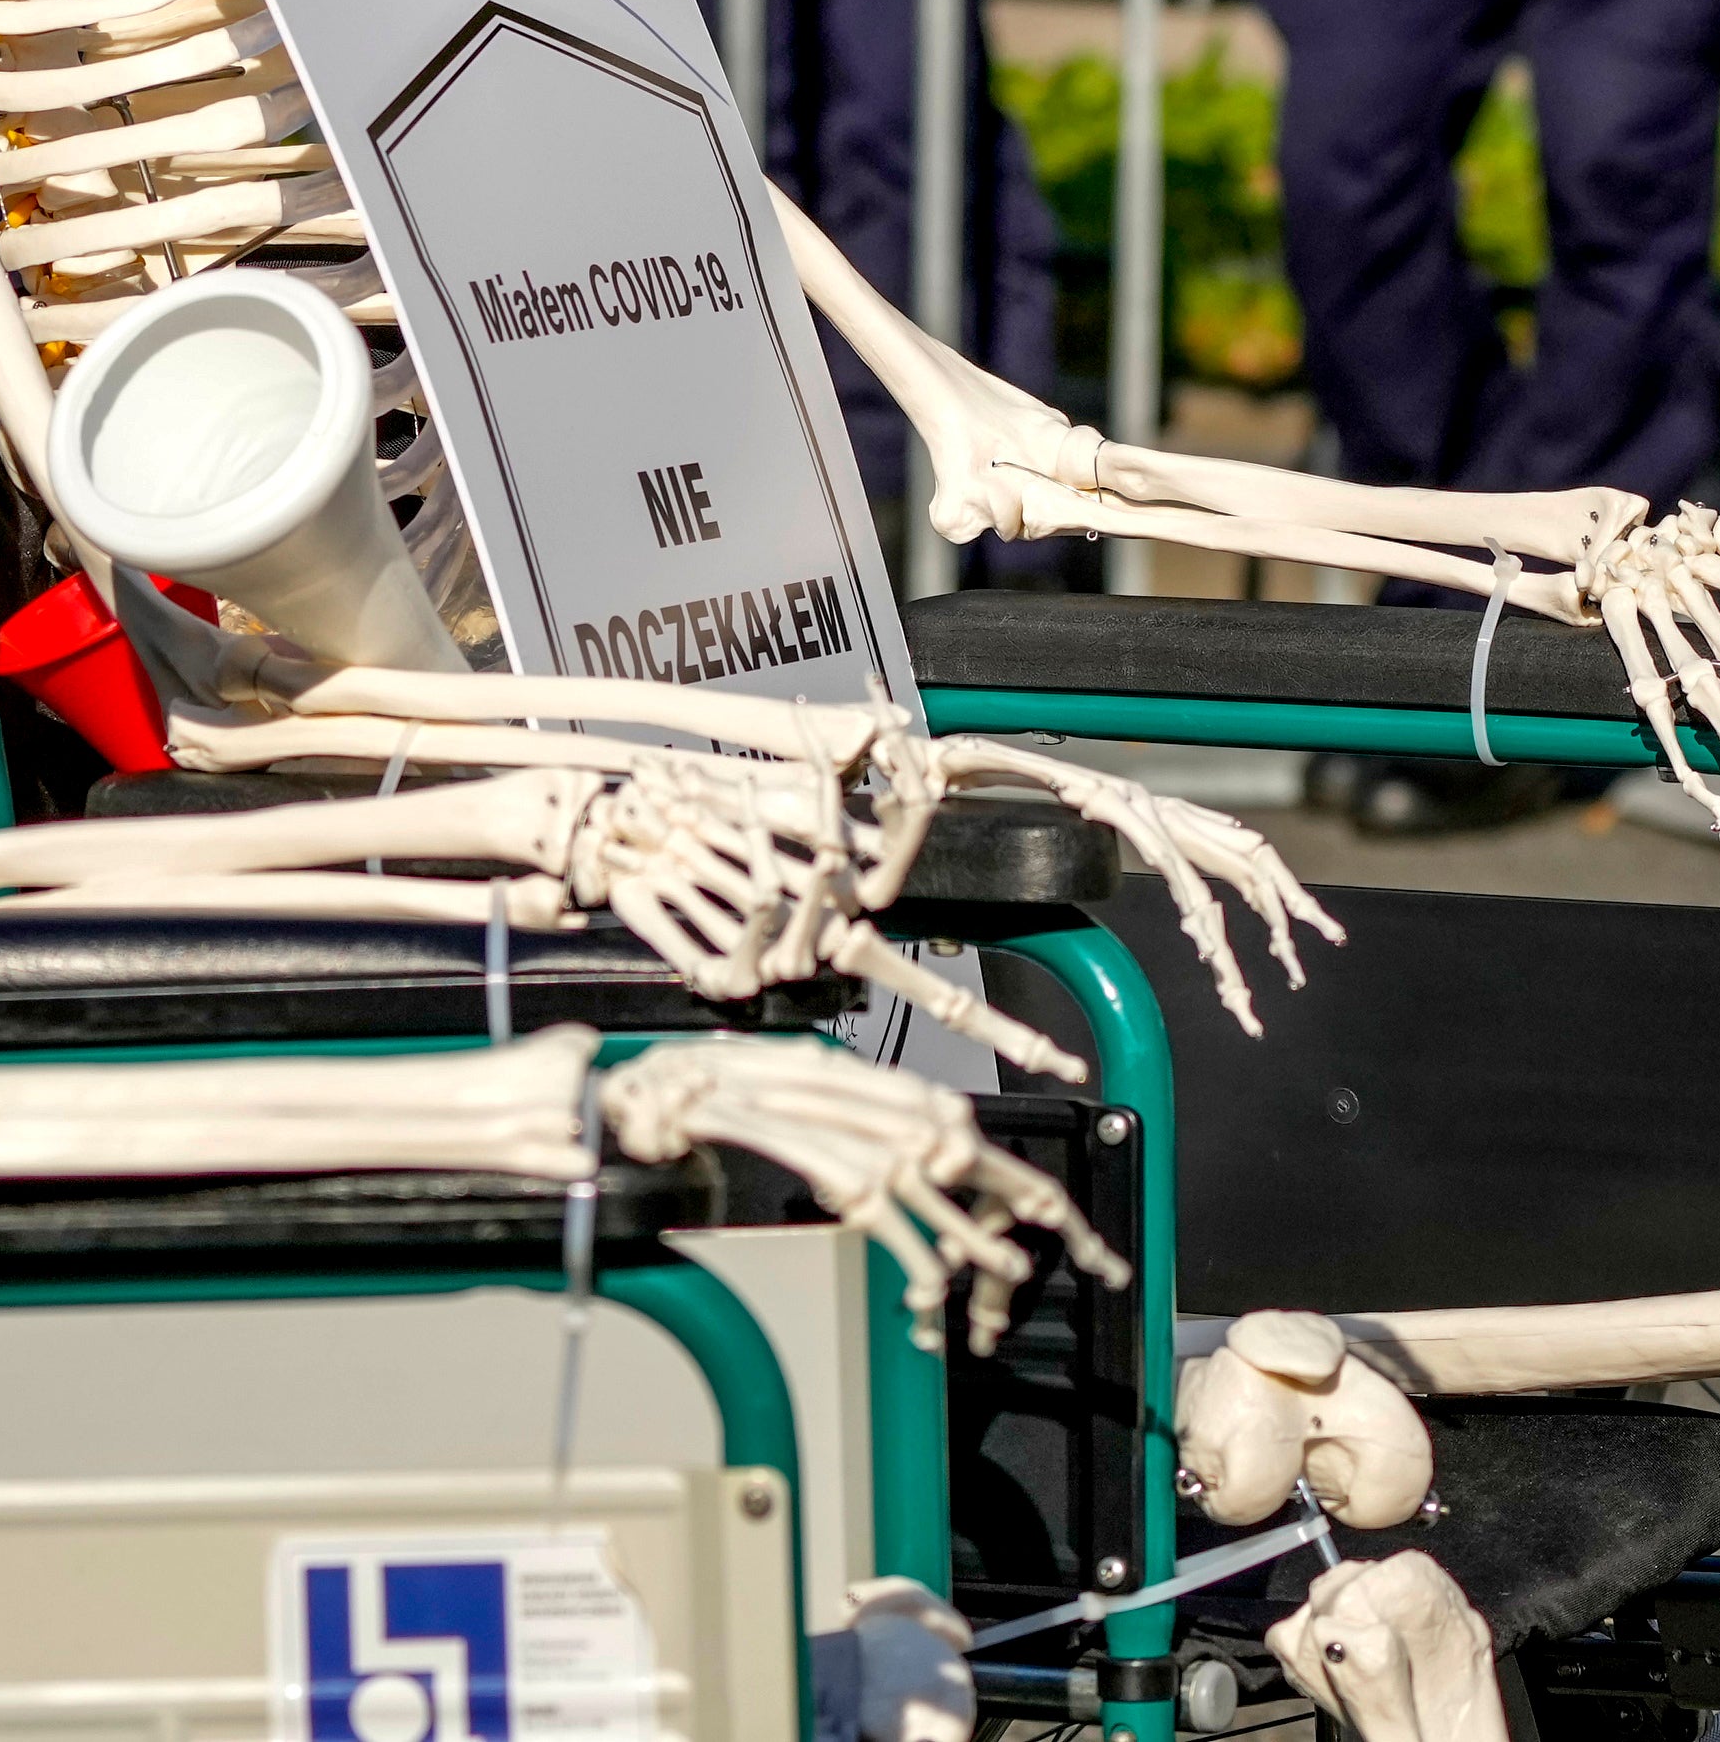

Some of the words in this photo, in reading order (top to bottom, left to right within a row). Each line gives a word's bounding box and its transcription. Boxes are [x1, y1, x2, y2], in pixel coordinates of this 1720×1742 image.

[469, 270, 595, 344] Miałem
[589, 252, 744, 326] COVID-19.
[637, 462, 722, 548] NIE
[574, 575, 853, 685] DOCZEKAŁEM
